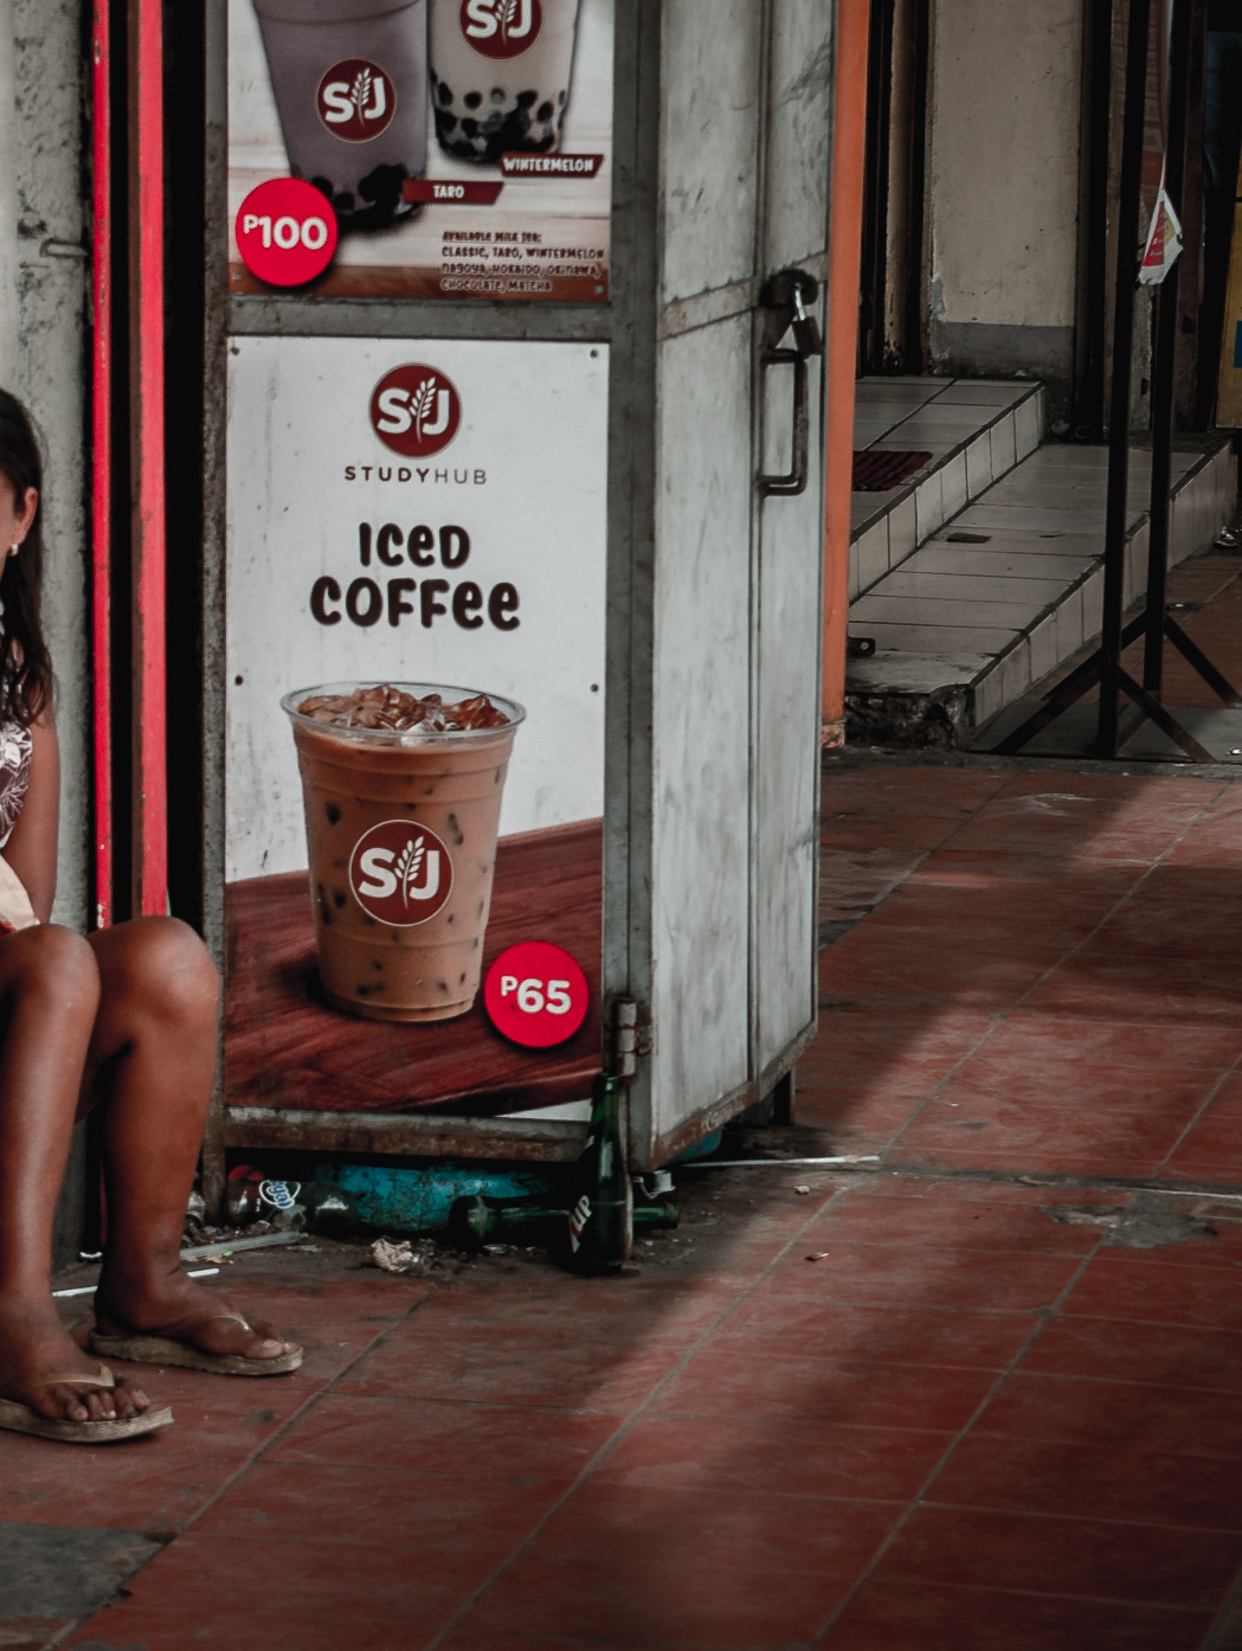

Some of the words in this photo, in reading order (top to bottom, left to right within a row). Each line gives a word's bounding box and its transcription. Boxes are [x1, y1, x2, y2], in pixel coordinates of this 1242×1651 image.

[502, 157, 594, 172] WINTERMELON
[433, 184, 465, 199] TARO
[441, 246, 490, 260] CLASSIC,
[492, 246, 523, 260] TARO,
[526, 247, 605, 261] WINTERMELON
